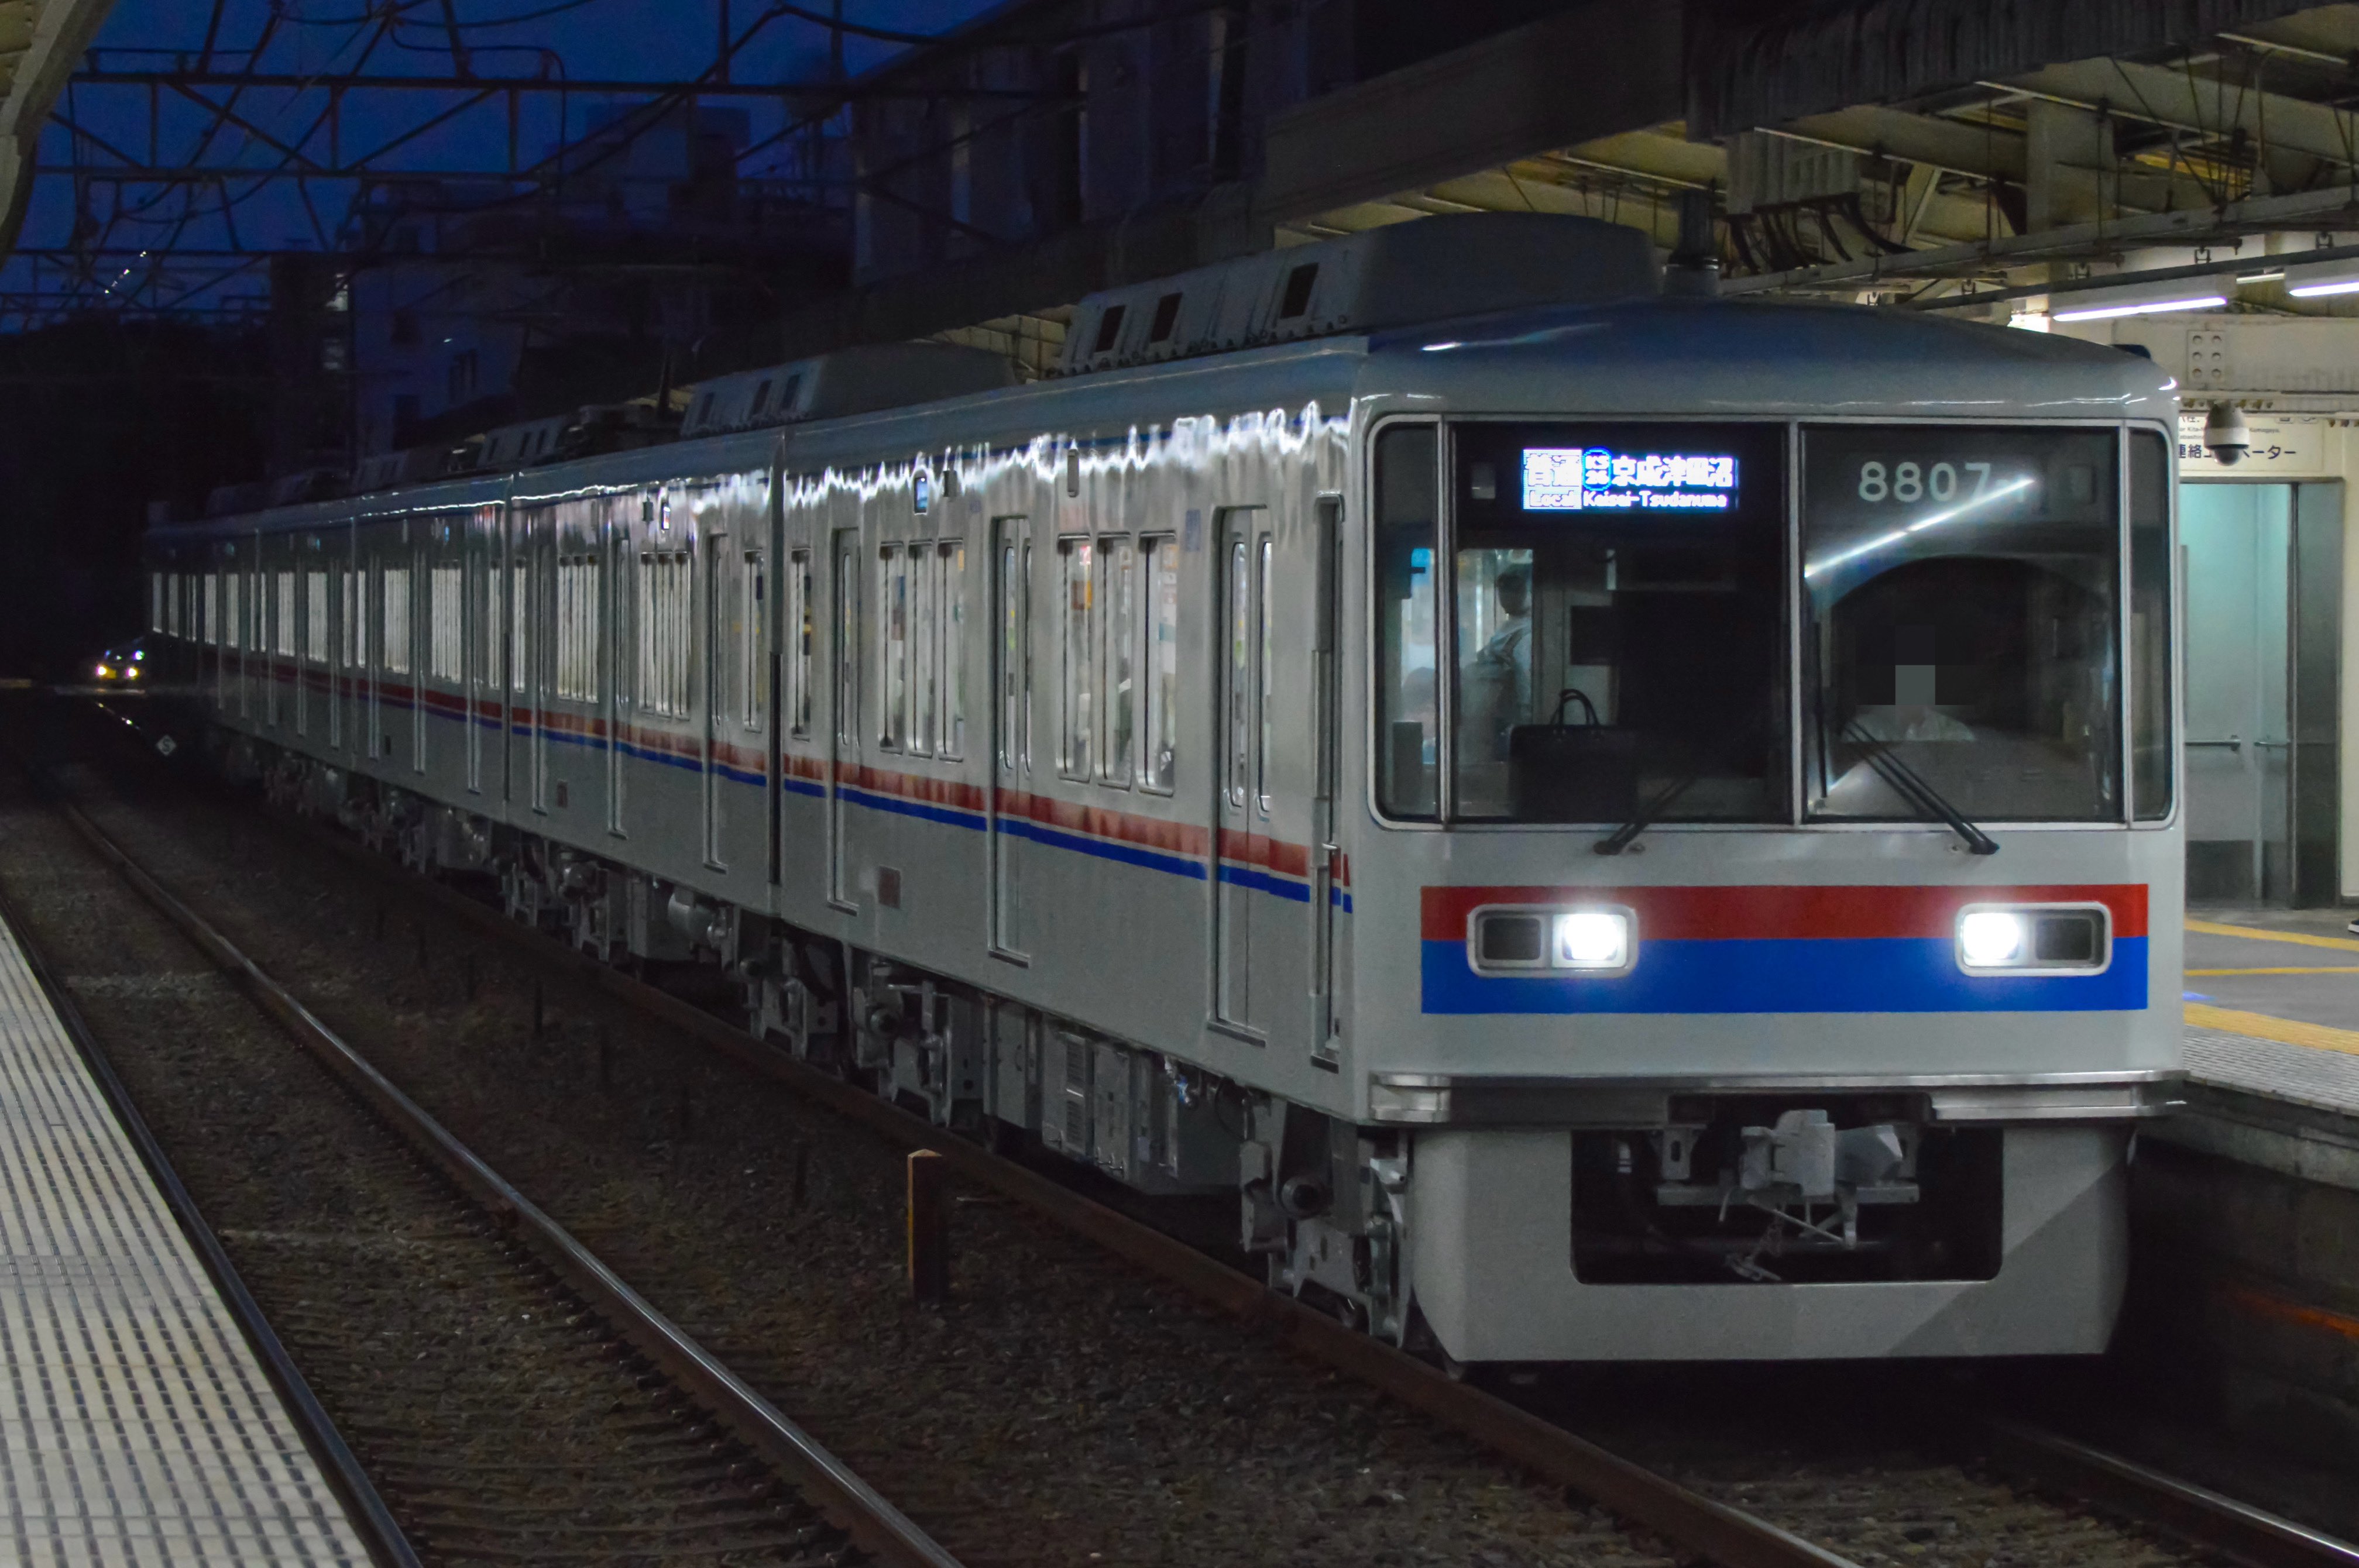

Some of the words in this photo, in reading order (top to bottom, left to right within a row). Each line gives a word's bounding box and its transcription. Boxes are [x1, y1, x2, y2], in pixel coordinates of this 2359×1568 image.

[1611, 455, 1733, 487] 京成津田沼
[1529, 490, 1574, 507] Local
[1583, 490, 1728, 507] Keisei-Tsudanuma
